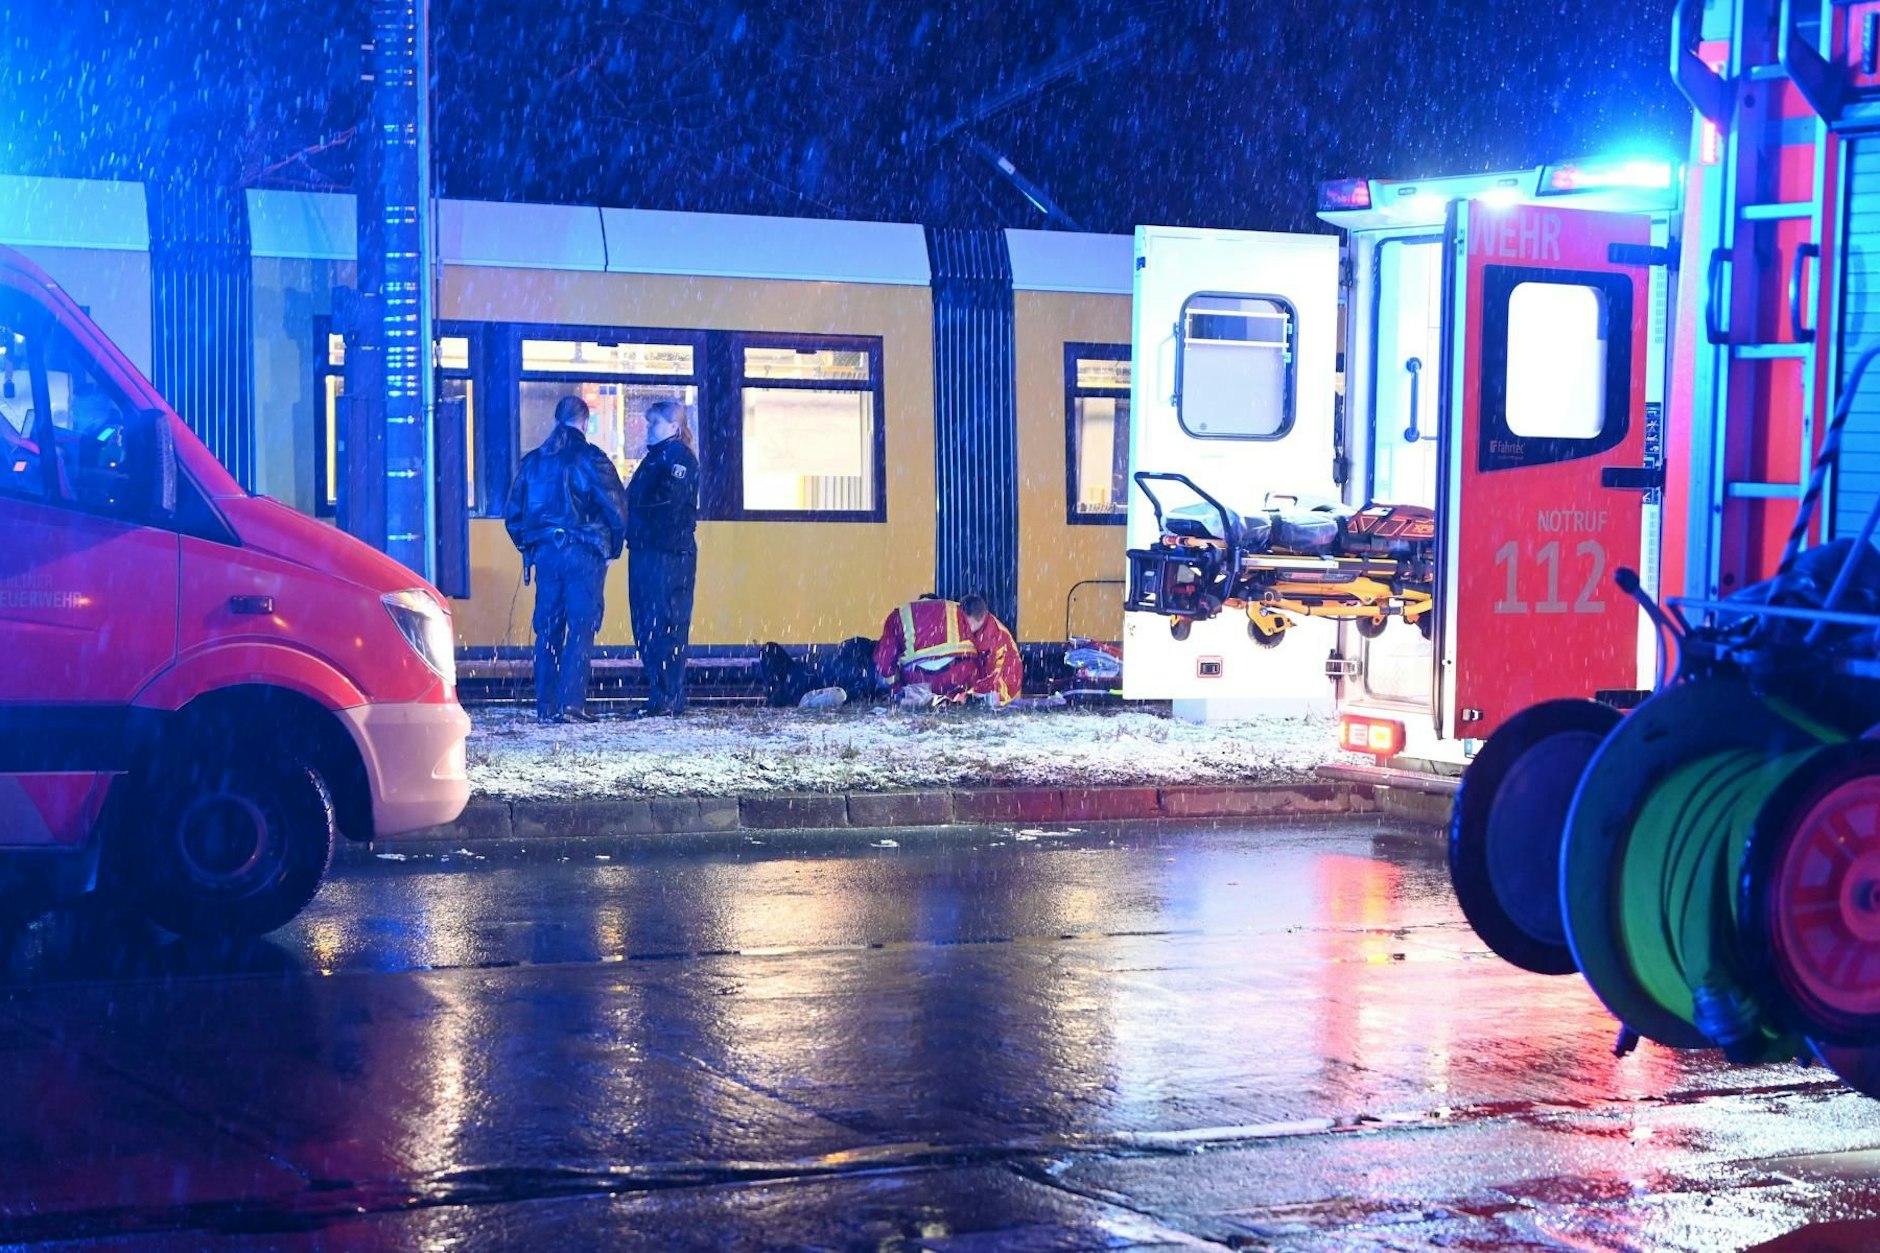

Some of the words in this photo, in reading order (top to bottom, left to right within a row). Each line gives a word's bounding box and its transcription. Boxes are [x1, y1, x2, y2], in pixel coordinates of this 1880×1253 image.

[1470, 211, 1560, 261] WEHR
[1538, 511, 1607, 532] NOTRUF
[1494, 540, 1606, 613] 112
